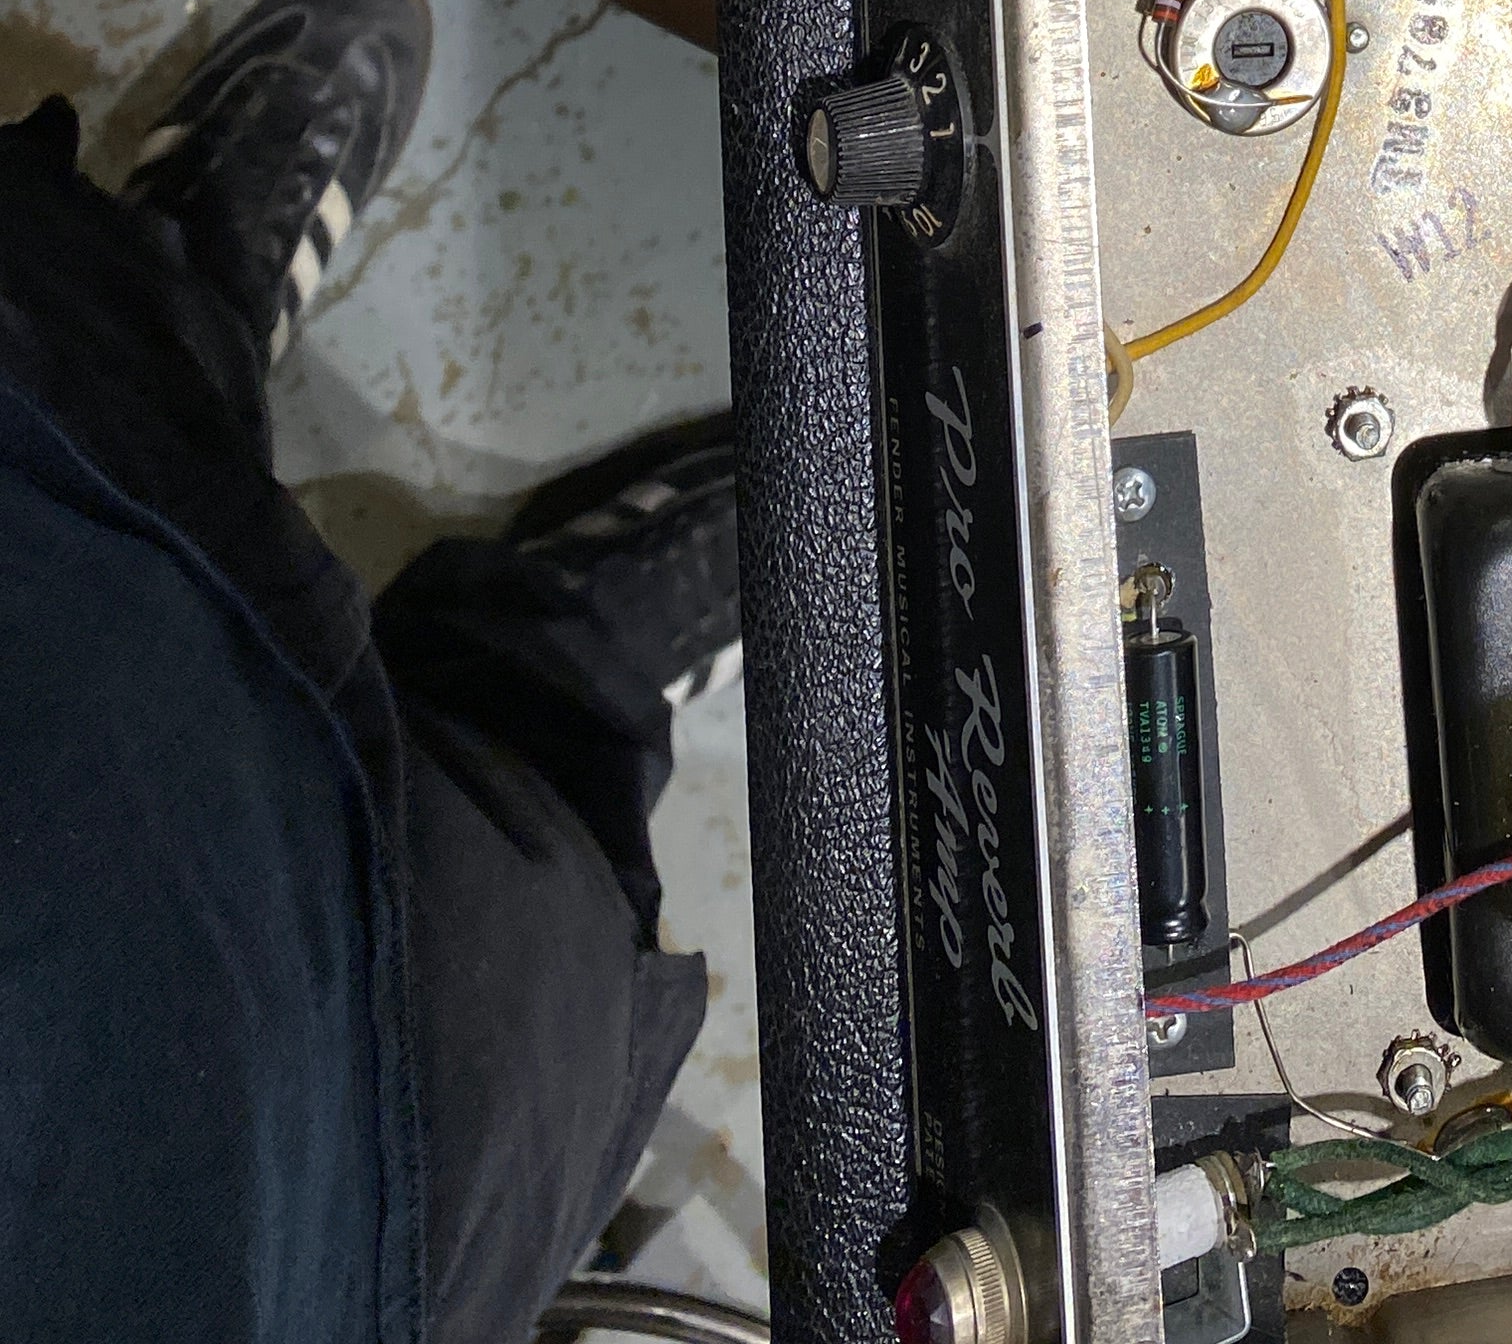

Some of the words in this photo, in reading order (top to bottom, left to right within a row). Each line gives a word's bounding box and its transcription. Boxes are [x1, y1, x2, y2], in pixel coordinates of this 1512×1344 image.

[909, 41, 932, 74] 3
[921, 72, 948, 106] 2
[930, 127, 955, 140] 1
[888, 396, 906, 524] FENDER
[893, 543, 914, 688] MUSICAL
[924, 365, 978, 623] Pro
[954, 652, 1038, 1033] Reverb
[1155, 700, 1169, 738] ATOM
[903, 709, 926, 953] INSTRUMENTS
[923, 722, 973, 970] Amp
